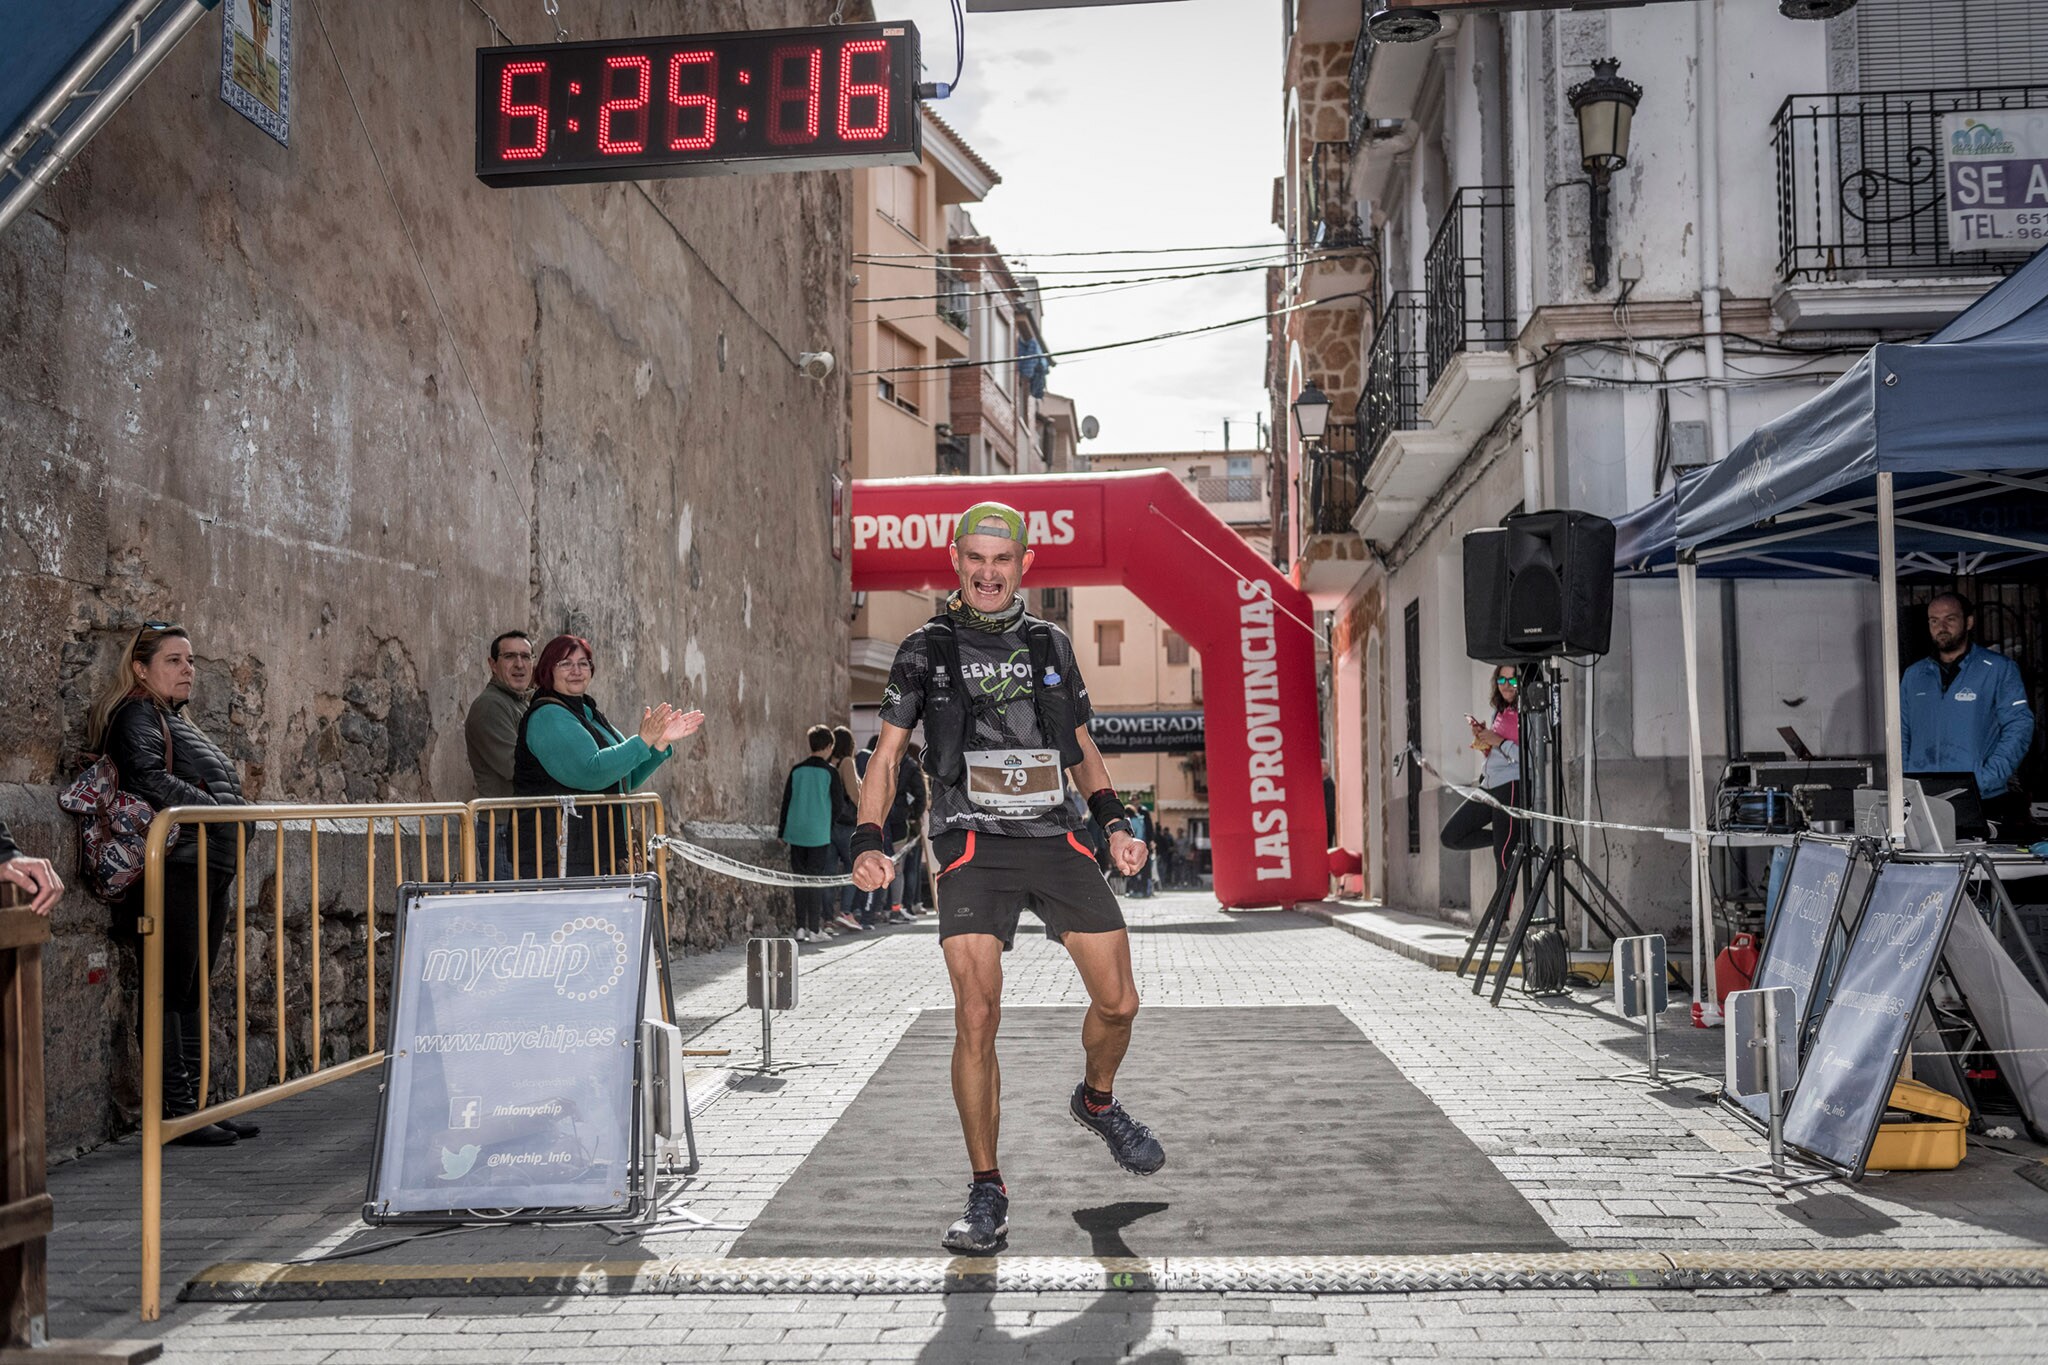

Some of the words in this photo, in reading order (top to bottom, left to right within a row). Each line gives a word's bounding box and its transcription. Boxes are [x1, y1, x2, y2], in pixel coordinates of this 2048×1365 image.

[500, 39, 890, 160] 5:25:16
[1957, 165, 2005, 205] SE
[2024, 164, 2048, 204] A
[852, 509, 1075, 550] PROVAS
[960, 662, 997, 679] EEN
[1237, 578, 1286, 804] PROVINCIAS
[1129, 735, 1153, 748] para
[1001, 769, 1028, 787] 79
[1252, 808, 1292, 881] LAS
[421, 932, 591, 992] mychip
[414, 1024, 617, 1055] www.mychip.es
[487, 1150, 572, 1168] @Mychip_Info
